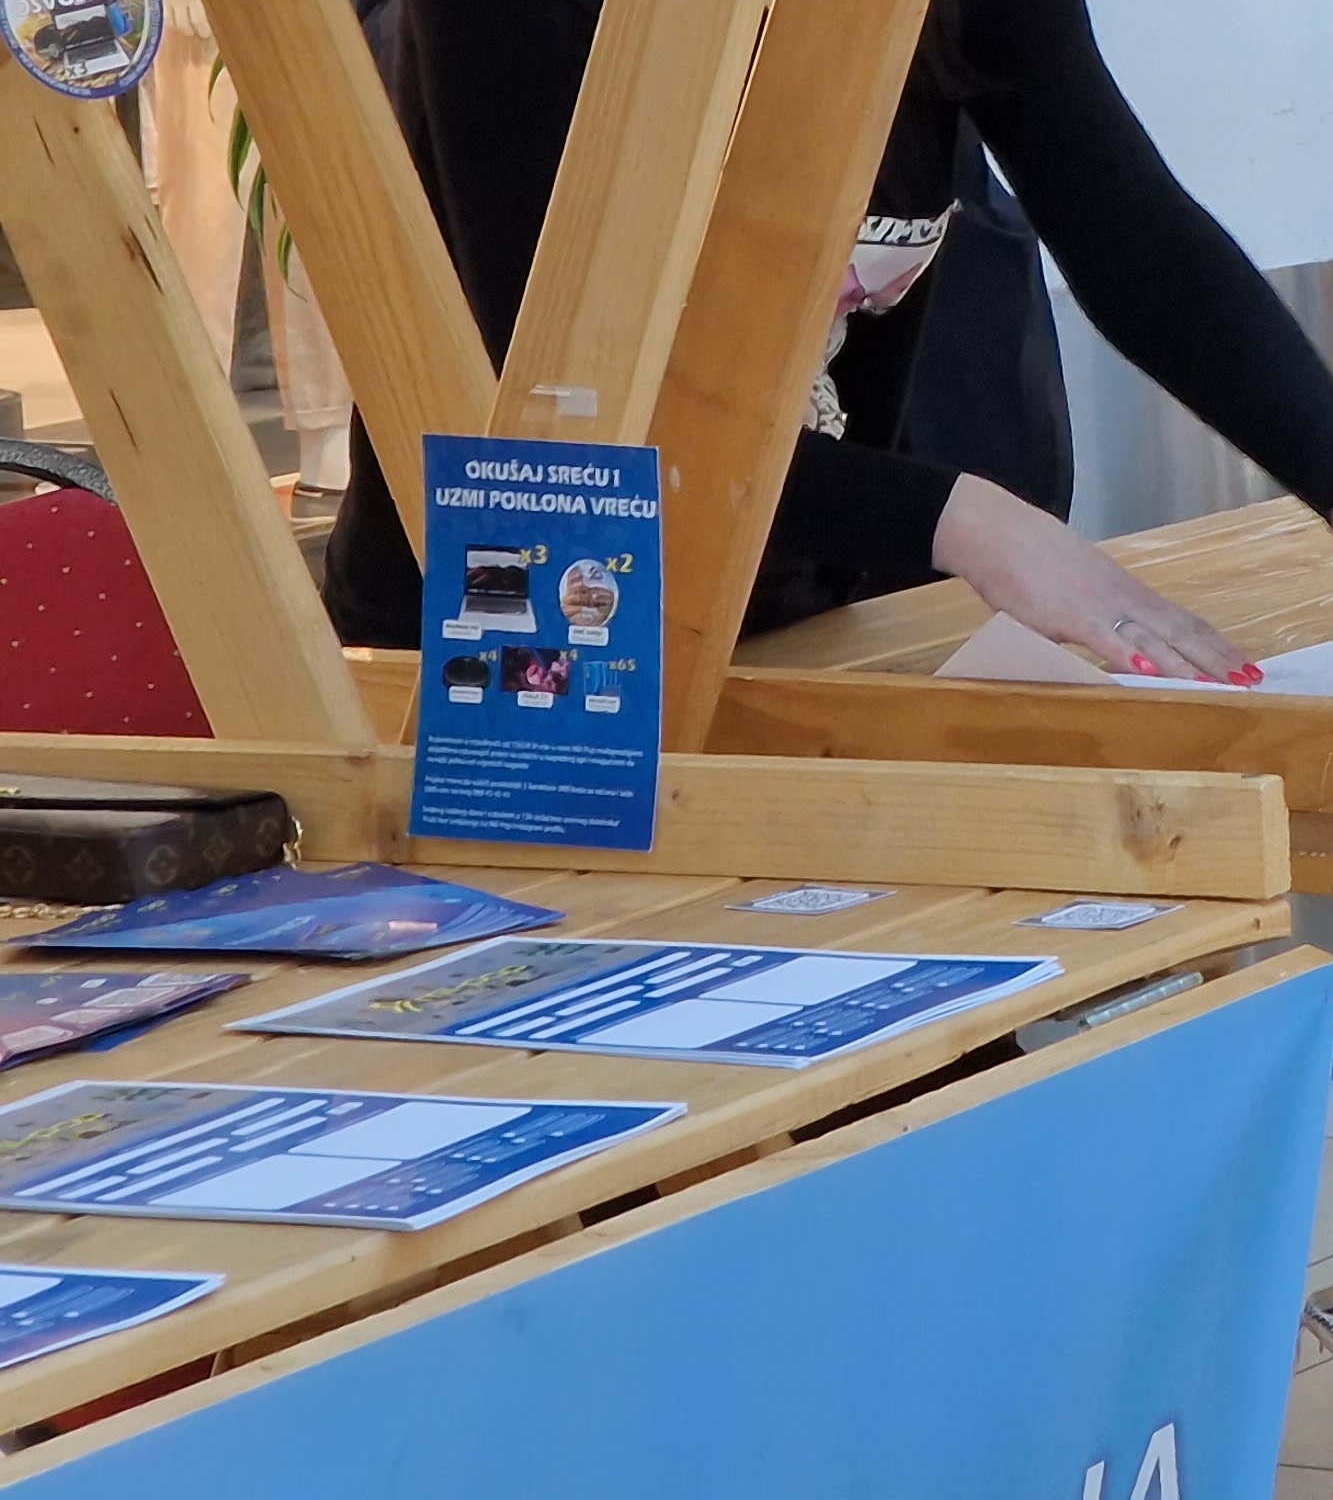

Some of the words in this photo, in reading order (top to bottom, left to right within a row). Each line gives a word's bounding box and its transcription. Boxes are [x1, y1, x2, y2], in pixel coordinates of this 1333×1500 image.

[465, 459, 543, 483] OKUŠAJ
[548, 463, 609, 487] SREĆU
[435, 487, 484, 509] UZMI
[489, 491, 587, 515] POKLONA
[592, 493, 656, 519] VREĆU
[519, 544, 548, 564] x3
[605, 553, 634, 573] x2
